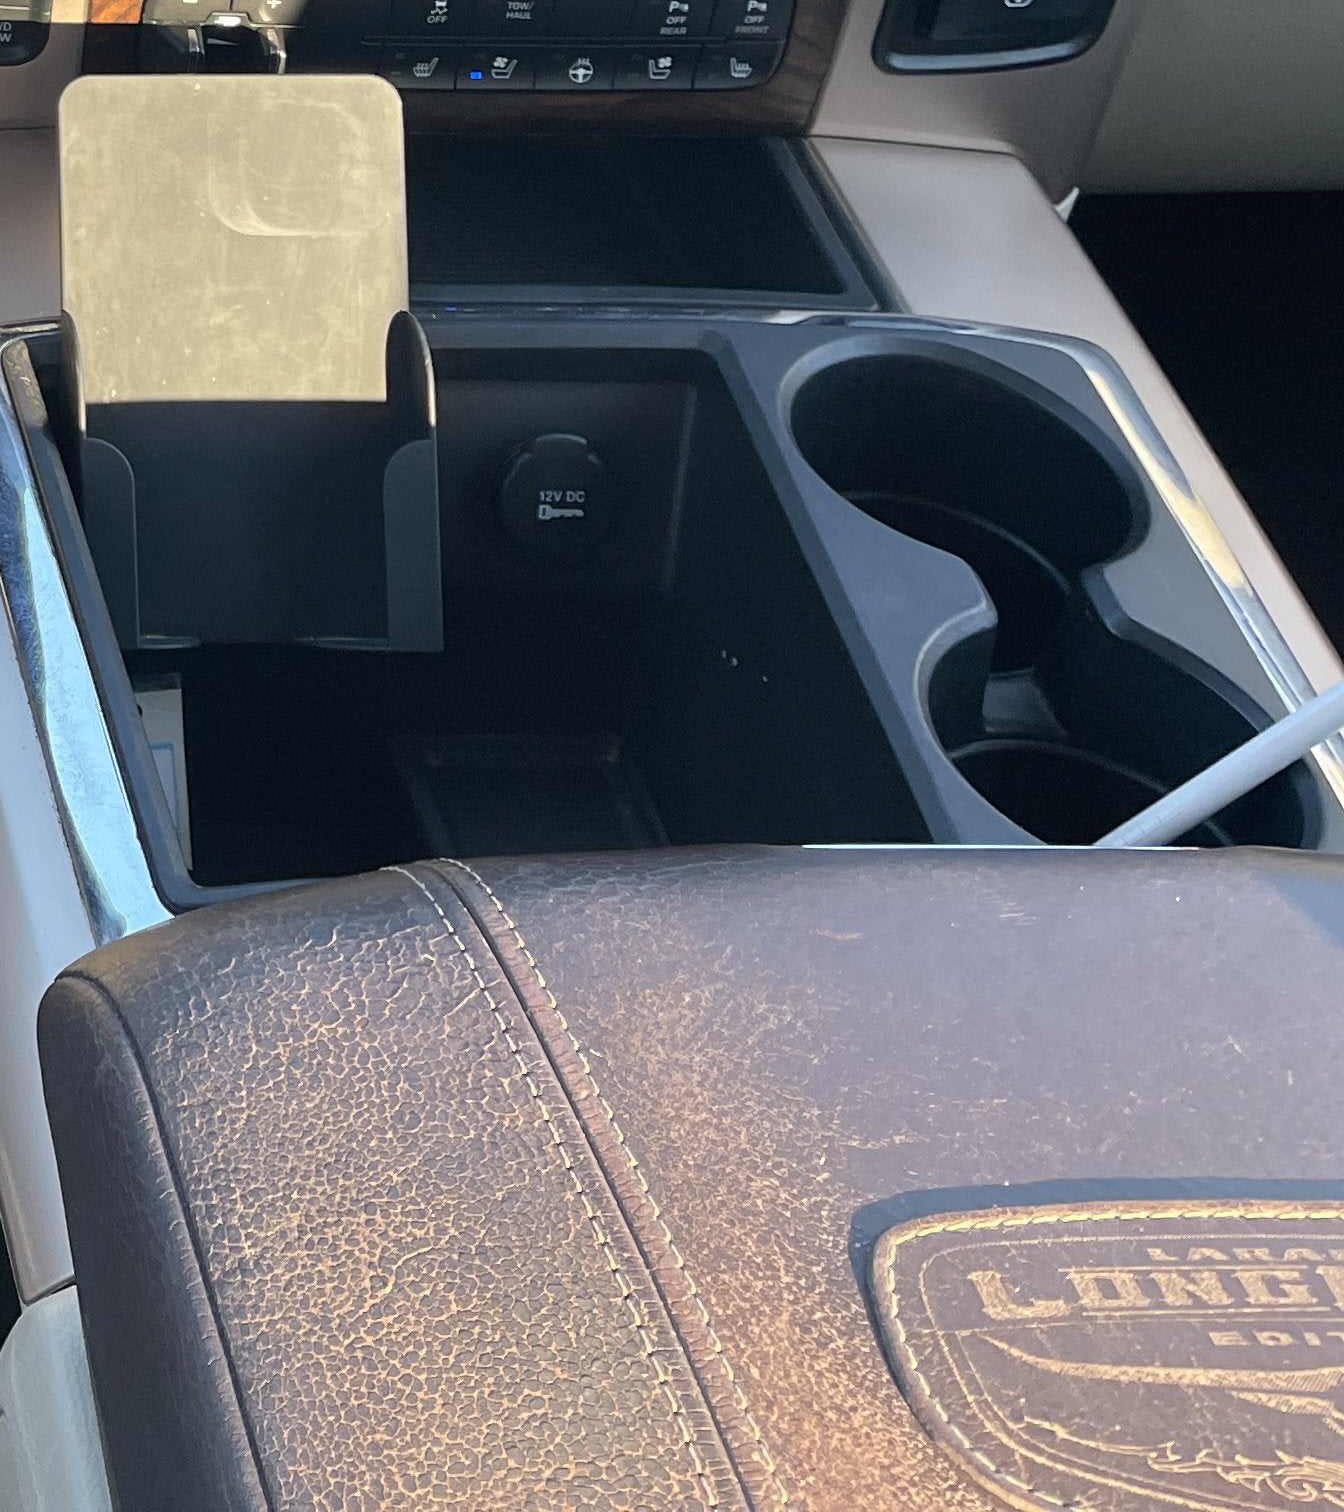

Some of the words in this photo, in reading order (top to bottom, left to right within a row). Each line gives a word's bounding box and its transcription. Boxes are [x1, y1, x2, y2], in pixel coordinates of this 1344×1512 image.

[426, 15, 448, 24] OFF
[539, 490, 562, 503] 12V
[565, 490, 586, 503] DC
